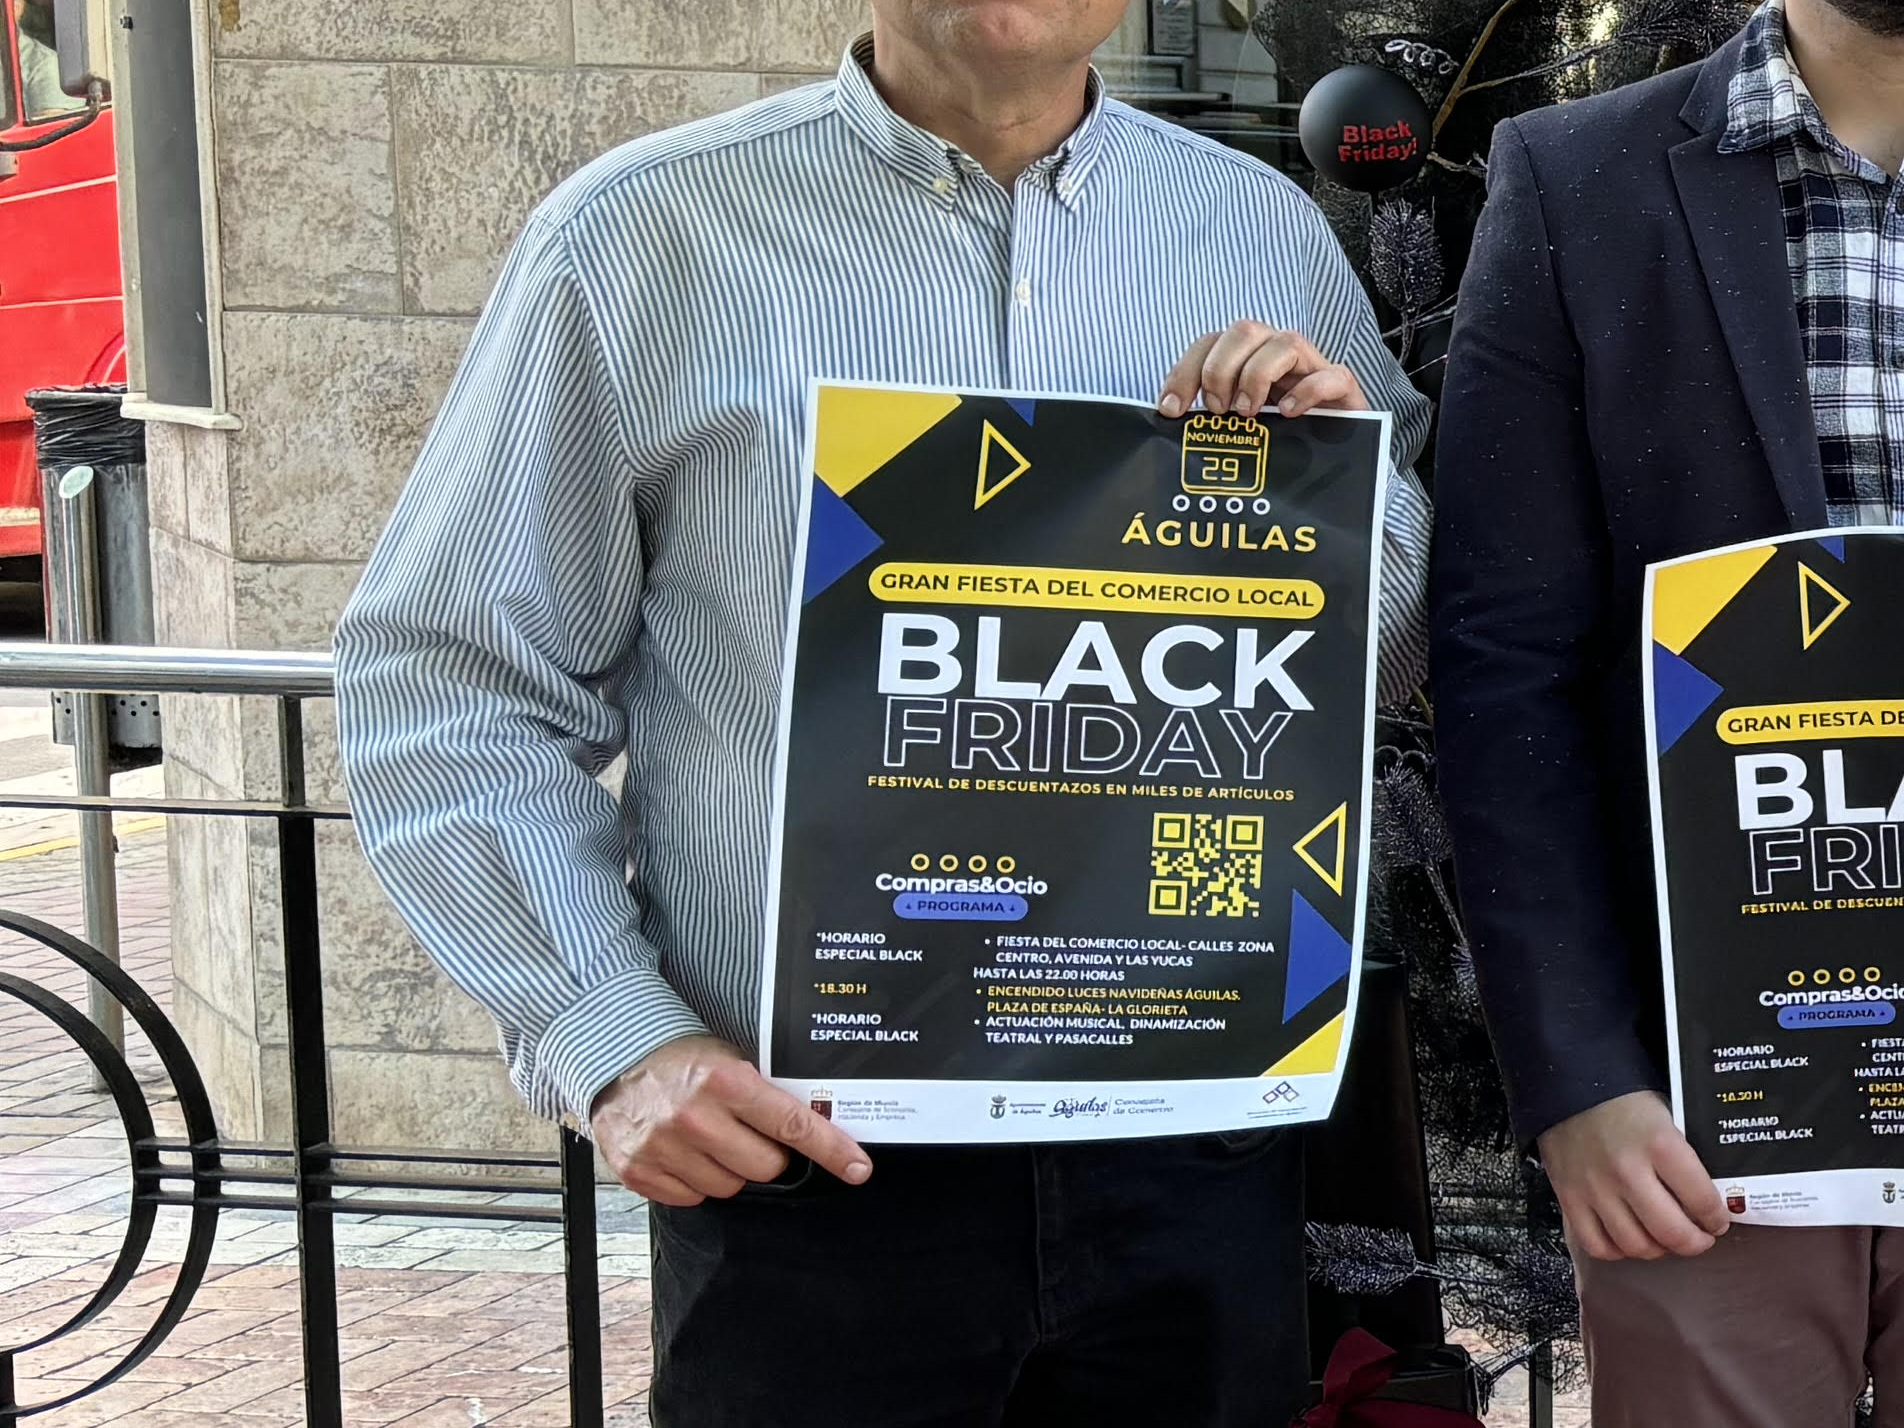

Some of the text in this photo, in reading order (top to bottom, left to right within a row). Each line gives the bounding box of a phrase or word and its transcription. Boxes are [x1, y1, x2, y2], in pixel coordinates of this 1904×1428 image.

[1343, 120, 1412, 143] Black
[1338, 137, 1417, 162] Friday!
[1187, 430, 1261, 447] NOVIEMBRE
[1201, 456, 1240, 481] 29
[1122, 513, 1317, 553] ÁGUILAS
[880, 573, 1315, 607] GRAN FIESTA DEL COMERCIO LOCAL
[878, 611, 1315, 711] BLACK
[1727, 715, 1791, 733] GRAN
[1798, 711, 1875, 729] FIESTA
[882, 697, 1293, 779] FRIDAY
[867, 775, 1294, 801] FESTIVAL DE DESCUENTAZOS EN MILES DE ARTÍCULOS
[876, 873, 1047, 897] Compras&Ocio
[917, 900, 1005, 913] PROGRAMA
[1741, 901, 1809, 915] FESTIVAL
[1812, 899, 1833, 910] DE
[996, 935, 1041, 947] FIESTA
[1042, 936, 1067, 949] DEL
[1068, 937, 1139, 950] COMERCIO
[1187, 940, 1234, 952] CALLES
[1237, 941, 1275, 953] ZONA
[815, 948, 923, 962] ESPECIAL BLACK
[995, 951, 1193, 967] CENTRO, AVENIDA Y LAS YUCAS
[973, 967, 1017, 979] HASTA
[1019, 968, 1043, 980] LAS
[1080, 969, 1125, 981] HORAS
[856, 983, 867, 994] H
[988, 985, 1066, 998] ENCENDIDO
[1067, 987, 1107, 999] LUCES
[1108, 987, 1183, 1000] NAVIDEÑAS
[987, 1001, 1029, 1013] PLAZA
[1031, 1002, 1049, 1013] DE
[1108, 1003, 1124, 1015] LA
[1126, 1004, 1188, 1016] GLORIETA
[1799, 1010, 1876, 1022] PROGRAMA
[985, 1015, 1064, 1028] ACTUACIÓN
[1129, 1018, 1226, 1030] DINAMIZACIÓN
[810, 1029, 919, 1042] ESPECIAL BLACK
[985, 1031, 1133, 1045] TEATRAL Y PASACALLES
